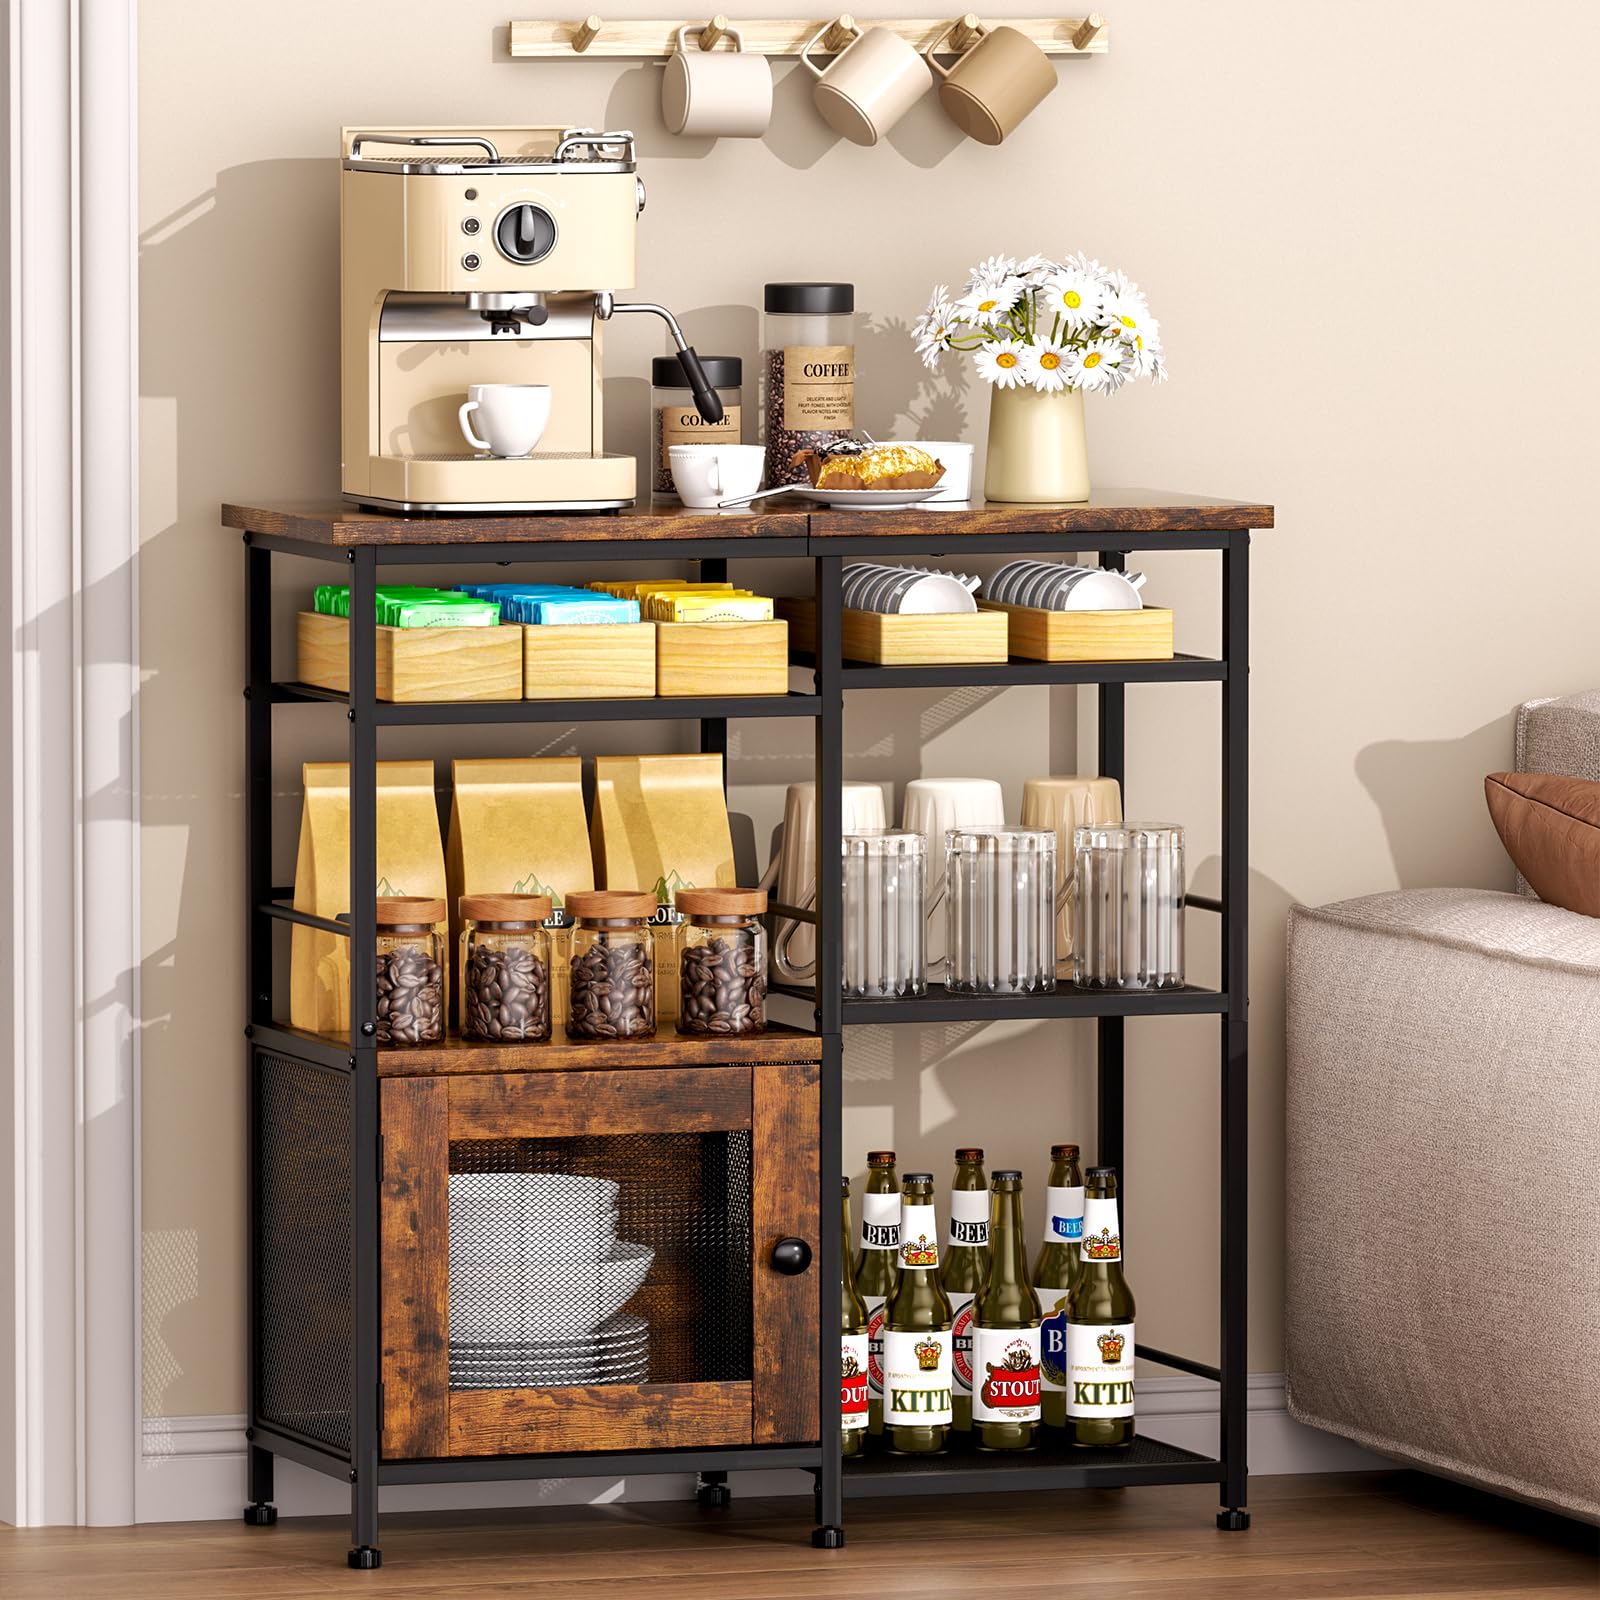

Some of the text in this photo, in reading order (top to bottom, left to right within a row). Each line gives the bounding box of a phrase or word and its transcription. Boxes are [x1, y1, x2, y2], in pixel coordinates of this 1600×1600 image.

[803, 363, 850, 378] COFFEE
[680, 414, 731, 427] COE
[867, 1224, 901, 1245] BEE
[841, 1385, 869, 1404] OUT
[990, 1379, 1041, 1397] STOUT
